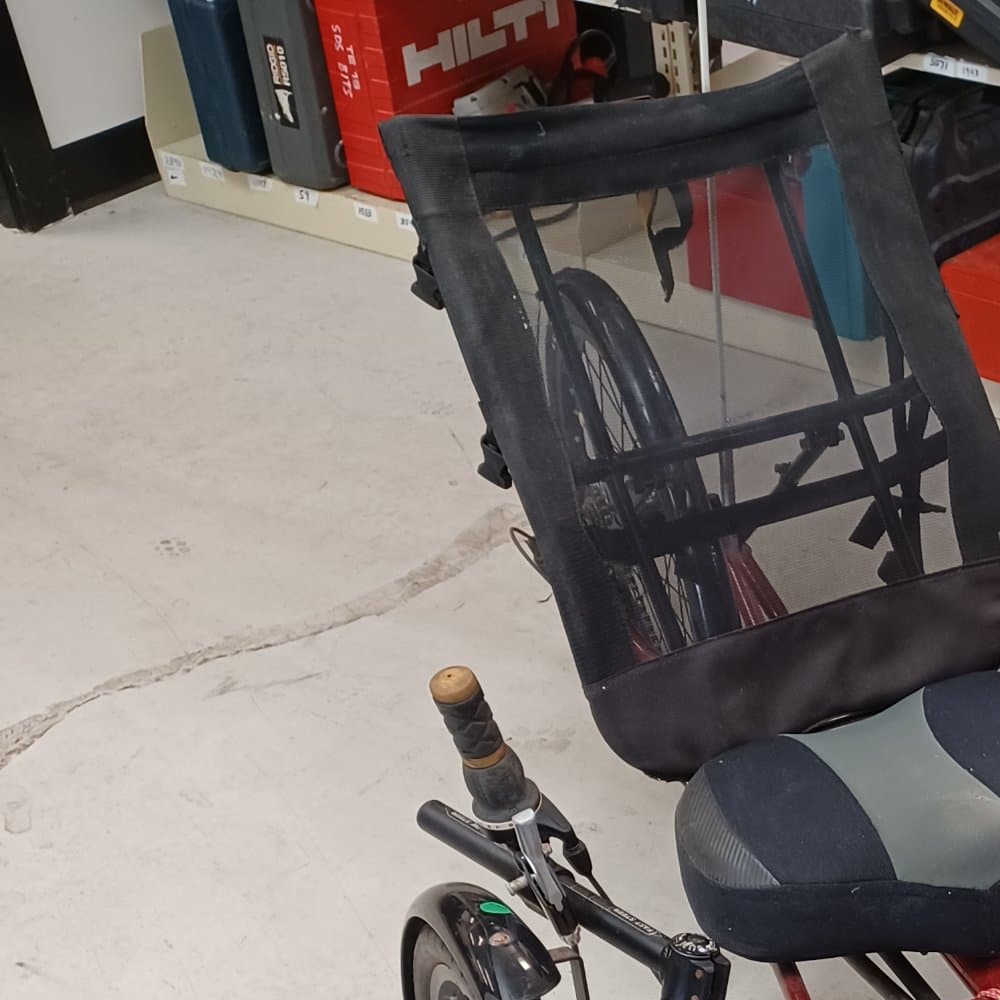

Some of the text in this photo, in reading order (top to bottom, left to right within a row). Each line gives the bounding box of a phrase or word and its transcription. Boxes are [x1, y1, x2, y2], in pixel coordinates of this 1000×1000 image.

[331, 23, 354, 99] SDS BITS
[402, 0, 559, 87] HILTI
